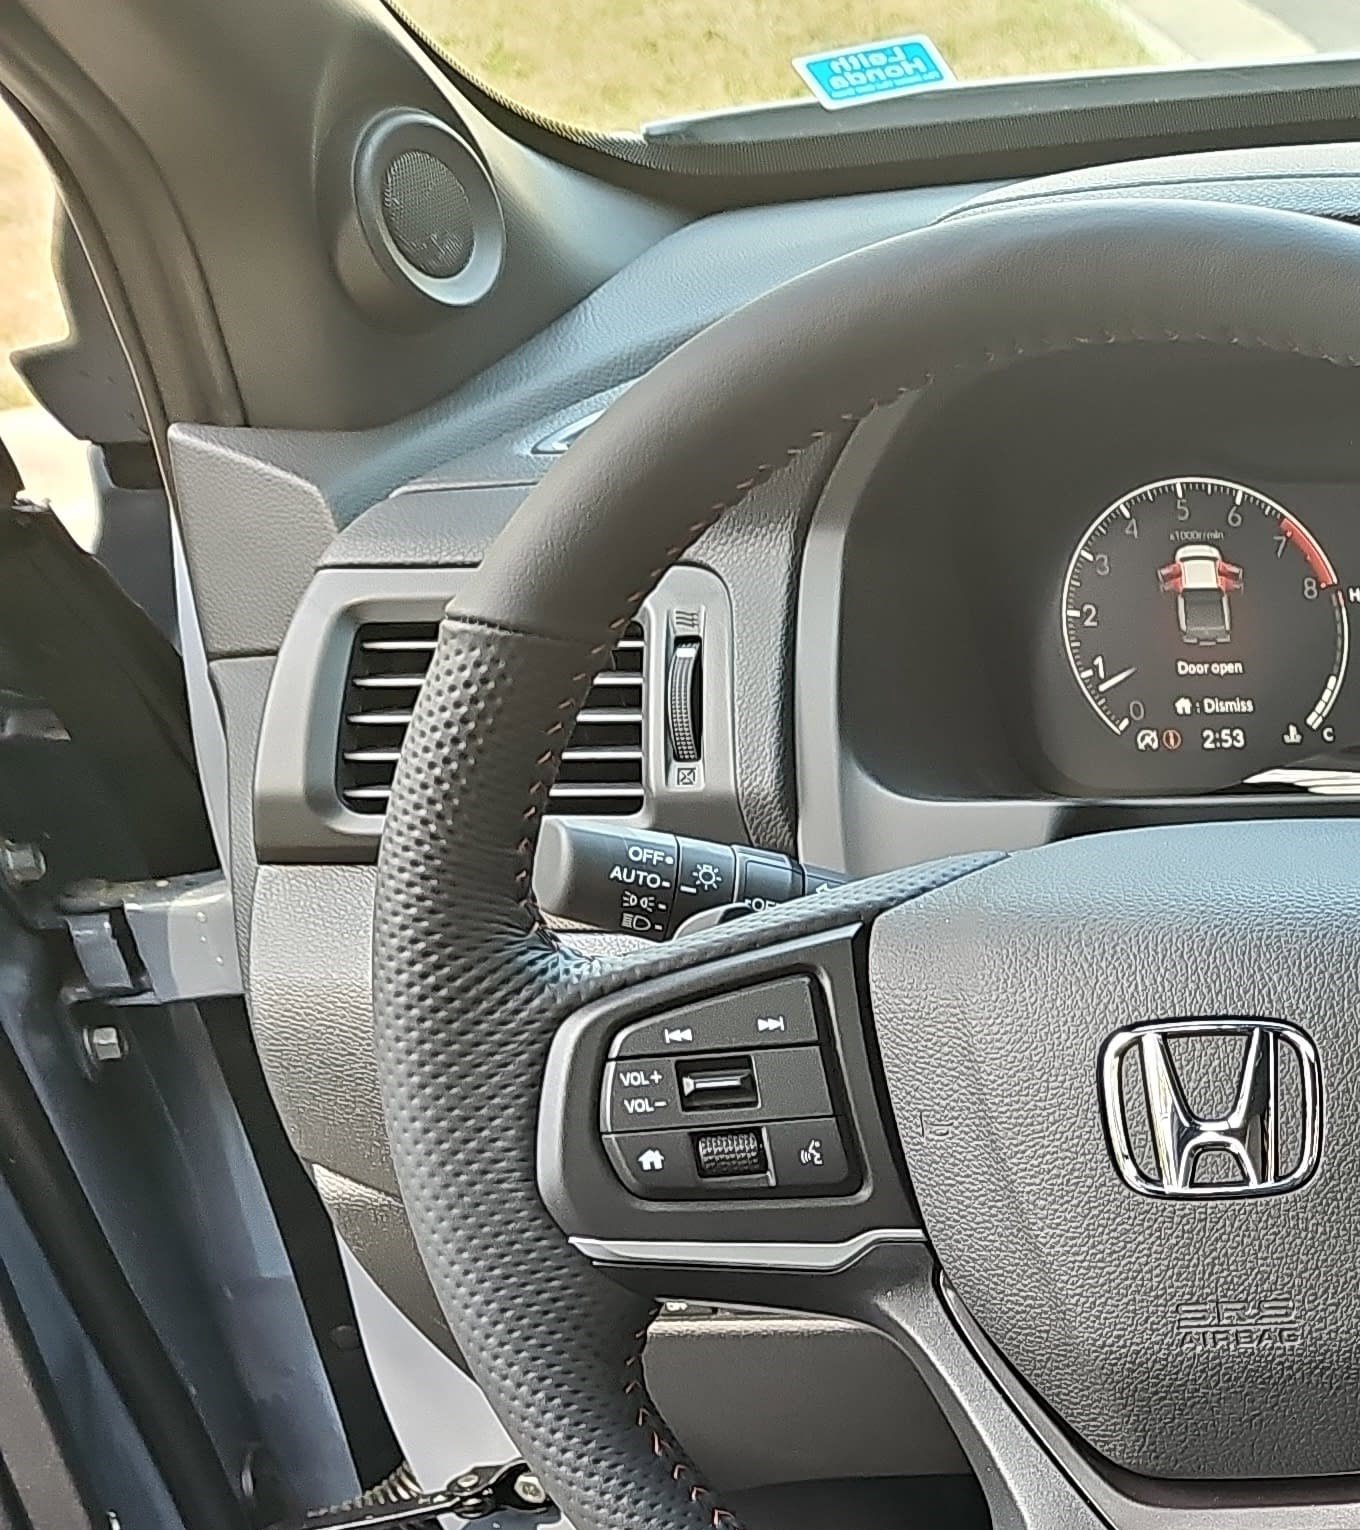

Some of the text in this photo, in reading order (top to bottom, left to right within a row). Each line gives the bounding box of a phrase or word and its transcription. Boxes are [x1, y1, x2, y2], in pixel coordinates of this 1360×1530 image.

[1177, 500, 1190, 521] 5
[1228, 506, 1243, 527] 6
[1124, 517, 1139, 539] 4
[1272, 535, 1287, 559] 7
[1095, 554, 1111, 577] 3
[1303, 577, 1318, 600] 8
[1349, 587, 1360, 603] H
[1082, 604, 1099, 627] 2
[1092, 655, 1106, 680] 1
[1176, 661, 1244, 679] Door open
[1129, 701, 1145, 721] 0
[1203, 698, 1254, 714] Dismiss
[1202, 729, 1246, 749] 2:53
[1322, 728, 1335, 743] C
[628, 847, 665, 864] OFF
[610, 865, 662, 888] AUTO
[1177, 1299, 1296, 1325] SRS
[1180, 1328, 1300, 1348] AIRBAG
